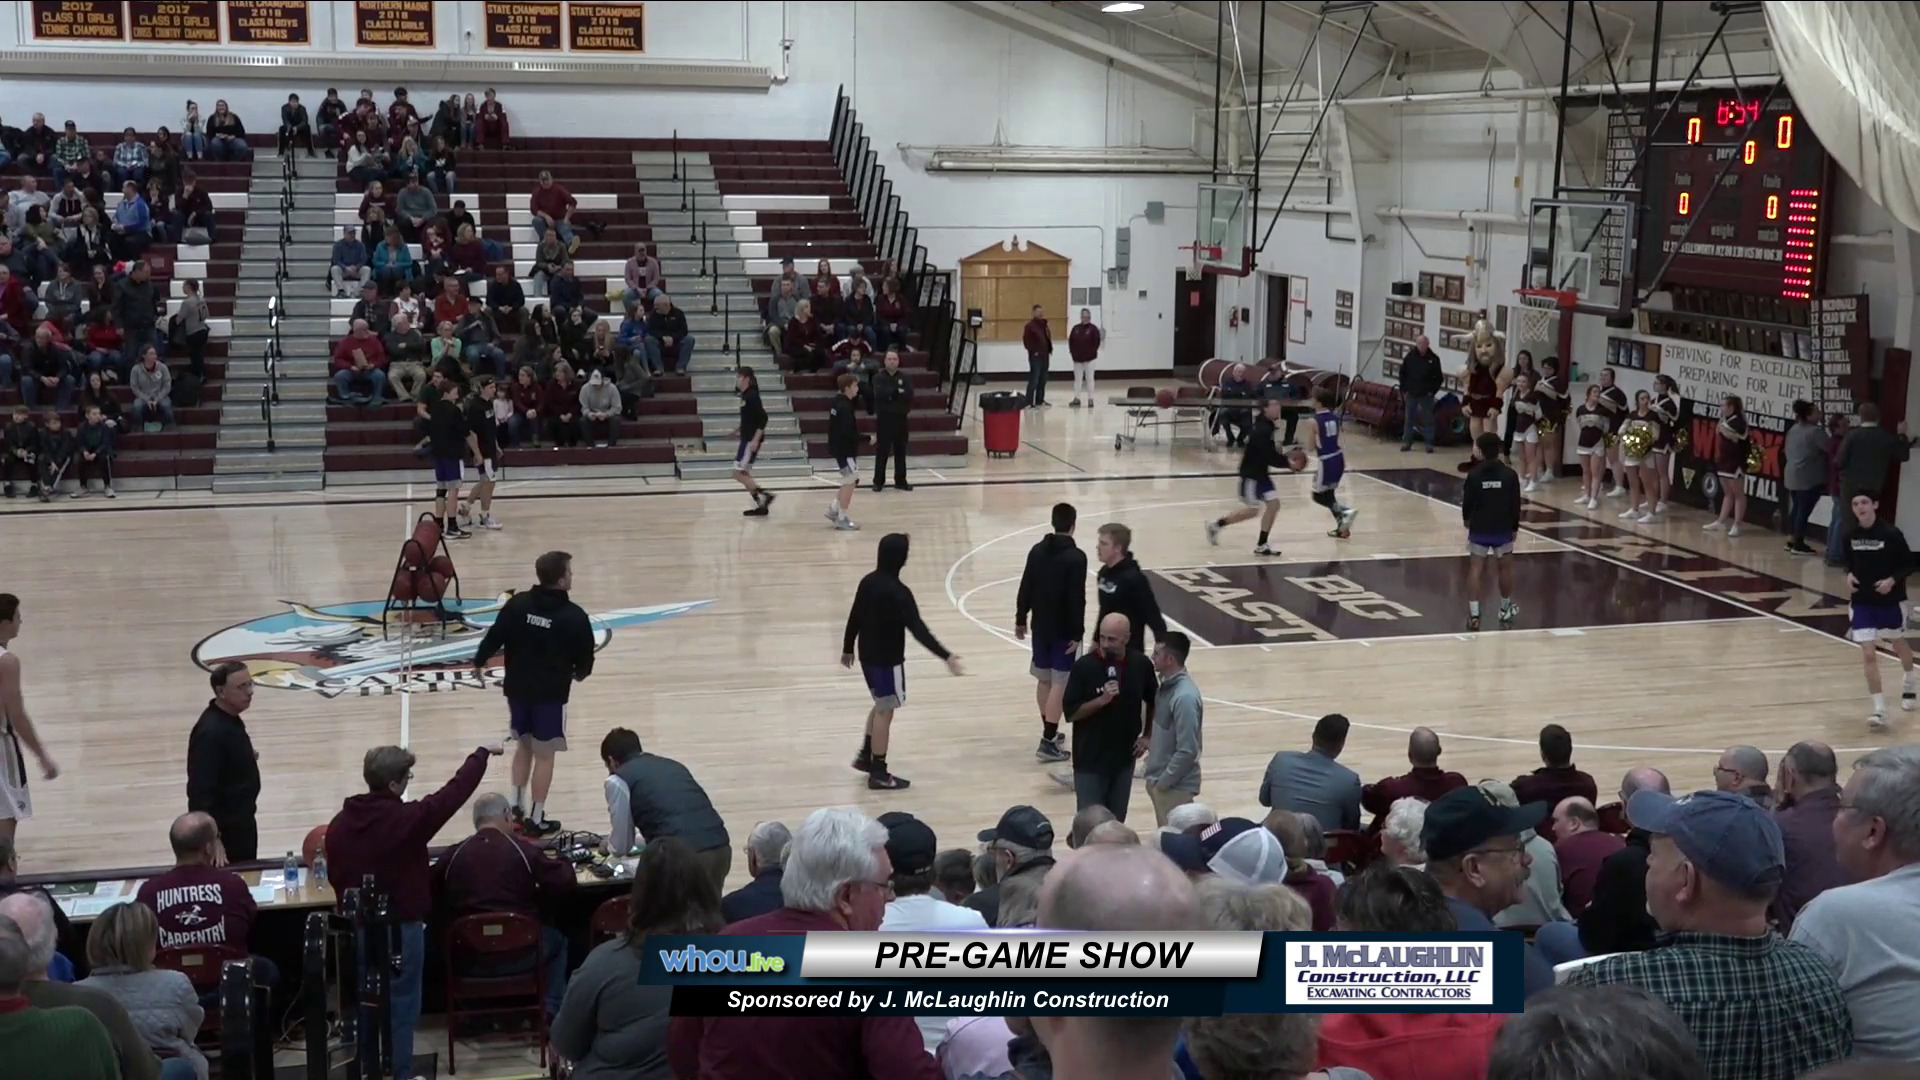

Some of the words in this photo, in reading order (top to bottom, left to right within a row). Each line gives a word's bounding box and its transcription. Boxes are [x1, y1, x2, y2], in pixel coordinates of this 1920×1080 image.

[61, 2, 93, 11] 2017
[157, 5, 190, 14] 2017
[359, 1, 401, 10] NORTHERN
[402, 2, 430, 11] MAINE
[487, 5, 512, 14] STATE
[512, 6, 559, 16] CHAMPIONS
[571, 6, 594, 16] STATE
[595, 7, 641, 17] CHAMPIONS
[42, 12, 73, 23] CLASS
[87, 14, 114, 23] GIRLS
[139, 15, 170, 26] CLASS
[183, 16, 210, 27] GIRLS
[238, 18, 265, 27] CLASS
[274, 19, 298, 28] BOYS
[41, 24, 70, 36] TENNIS
[72, 25, 117, 37] CHAMPIONS
[365, 20, 392, 29] CLASS
[401, 21, 424, 30] GIRLS
[495, 25, 521, 34] CLASS
[530, 26, 552, 35] BOYS
[578, 26, 604, 35] CLASS
[613, 27, 634, 36] BOYS
[133, 27, 153, 38] CROSS
[155, 28, 181, 39] COUNTRY
[184, 28, 216, 40] CHAMPIONS
[250, 28, 288, 39] TENNIS
[362, 30, 387, 40] TENNIS
[388, 31, 429, 42] CHAMPIONS
[507, 35, 541, 46] TRACK
[576, 37, 637, 48] BASKETBALL
[1777, 116, 1793, 148] 0
[1744, 140, 1756, 164] 0
[1679, 192, 1689, 215] 0
[1767, 195, 1778, 219] 0
[1822, 337, 1841, 350] ELLIS
[1665, 344, 1712, 365] STRIVING
[1720, 353, 1742, 370] FOR
[1750, 358, 1812, 381] EXCELLEN
[1678, 365, 1739, 388] PREPARING
[1746, 376, 1768, 394] FOR
[1778, 381, 1805, 399] LIFE
[1678, 384, 1698, 400] LAY
[1745, 396, 1775, 416] PLAY
[1693, 402, 1708, 417] ONE
[1758, 415, 1785, 432] COULD
[1743, 473, 1757, 497] IT
[1756, 478, 1780, 503] ALL
[1284, 574, 1423, 620] BIG
[1151, 567, 1340, 641] EAST
[526, 613, 553, 629] YOUNG
[156, 883, 223, 914] HUNTRESS
[158, 914, 226, 949] CARPENTRY
